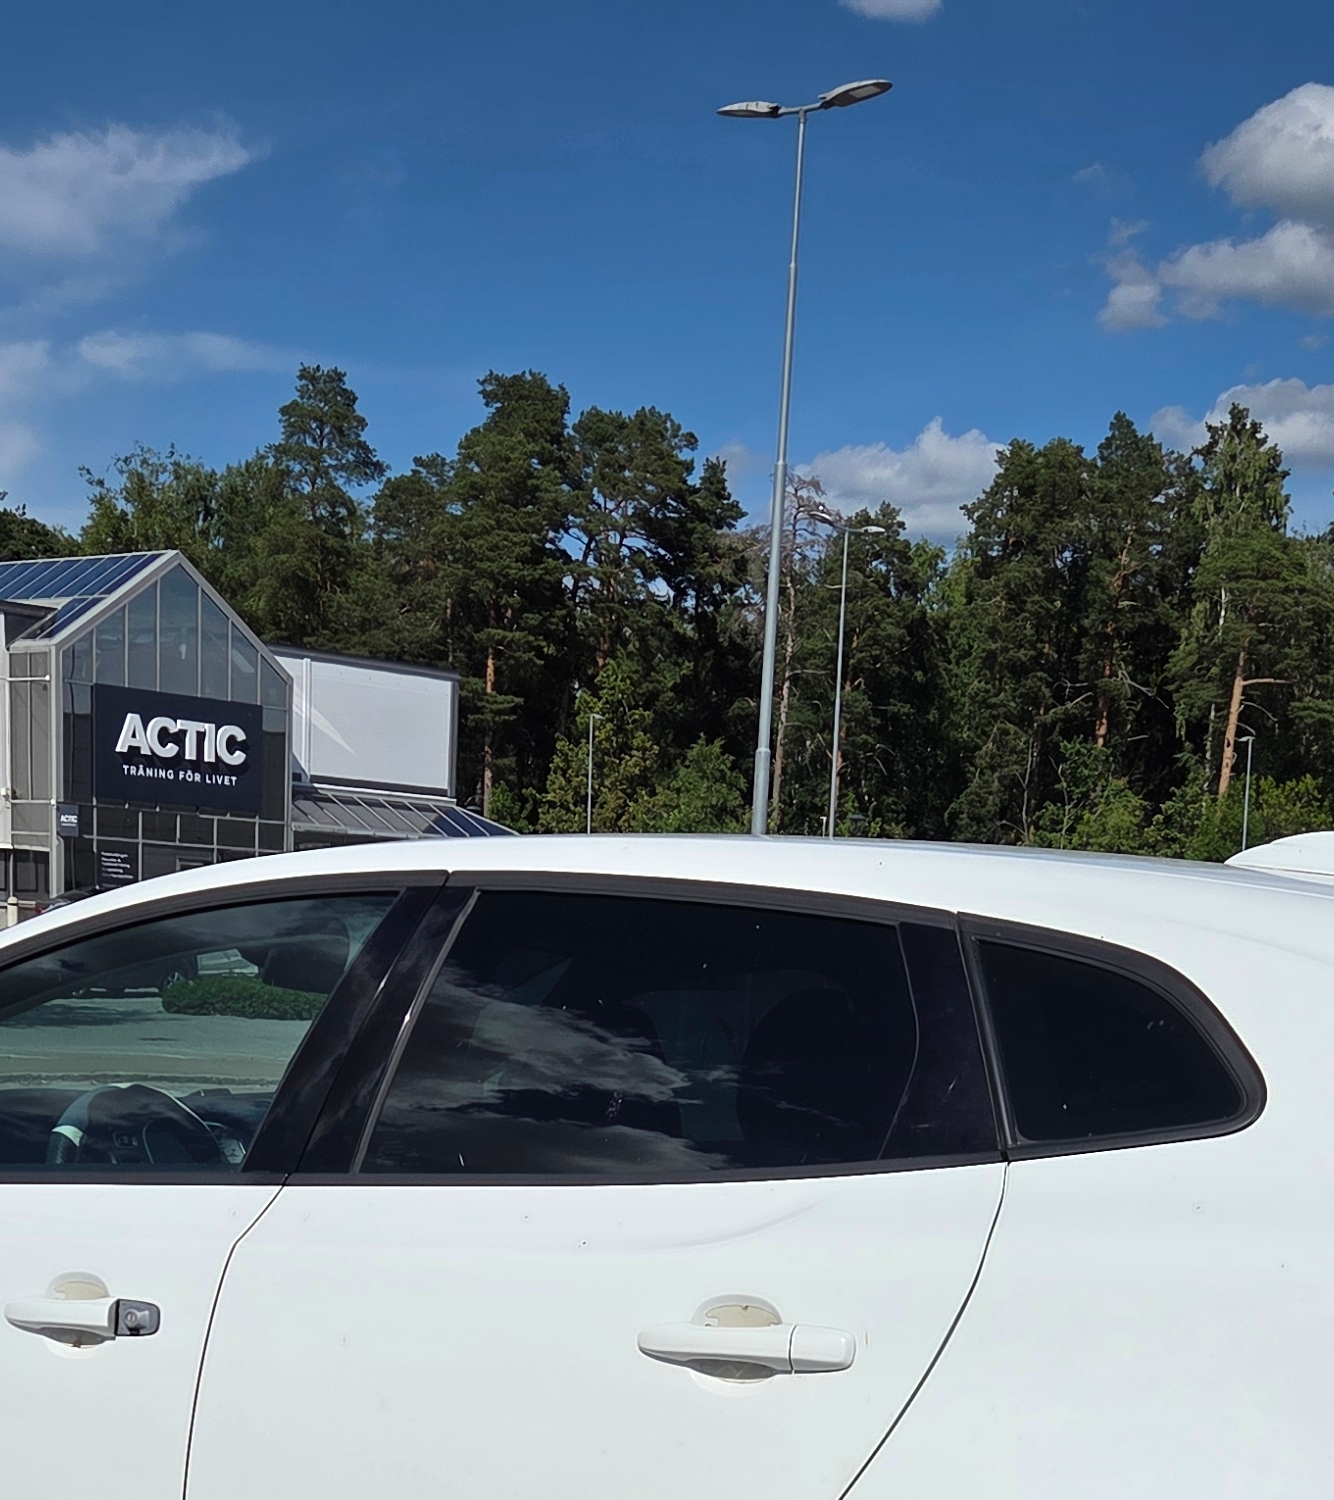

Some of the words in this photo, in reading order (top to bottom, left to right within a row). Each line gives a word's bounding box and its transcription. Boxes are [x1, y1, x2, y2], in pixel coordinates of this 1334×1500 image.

[115, 712, 247, 766] ACTIC
[123, 764, 174, 780] TRÄNING
[179, 768, 201, 783] FÖR
[206, 773, 237, 786] LIVET
